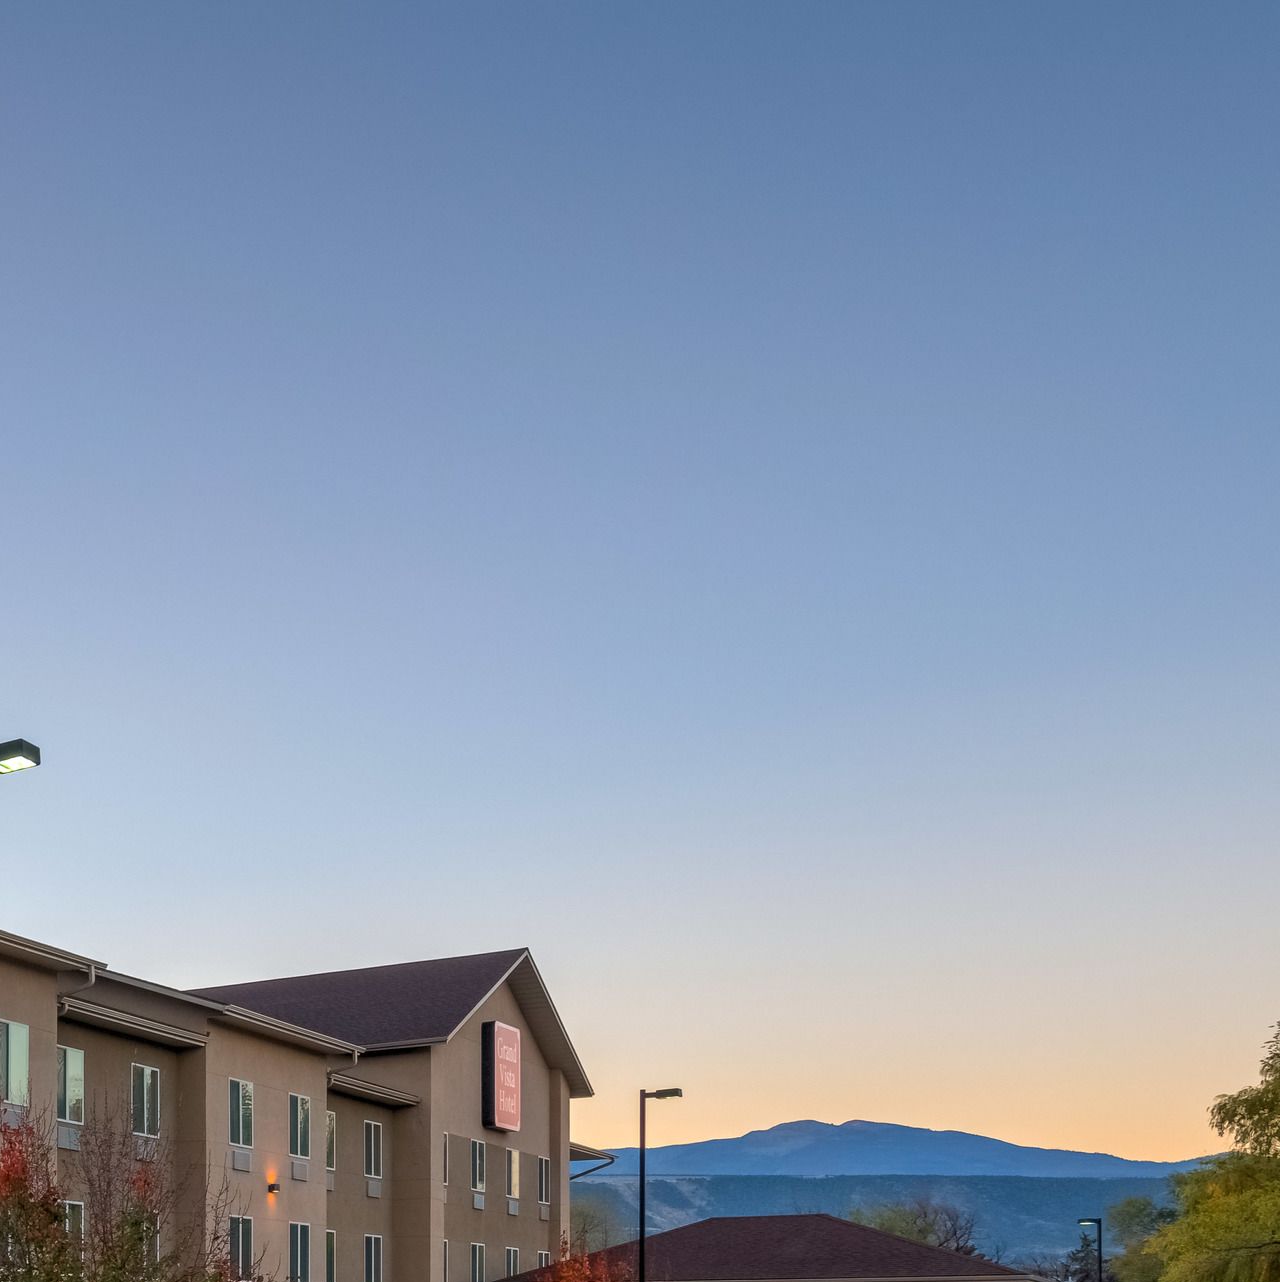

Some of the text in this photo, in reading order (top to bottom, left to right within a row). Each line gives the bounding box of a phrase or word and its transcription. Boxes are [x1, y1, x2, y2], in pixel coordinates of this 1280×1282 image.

[497, 1038, 517, 1063] Grand
[499, 1064, 515, 1088] Vista
[499, 1090, 516, 1114] Hotel
